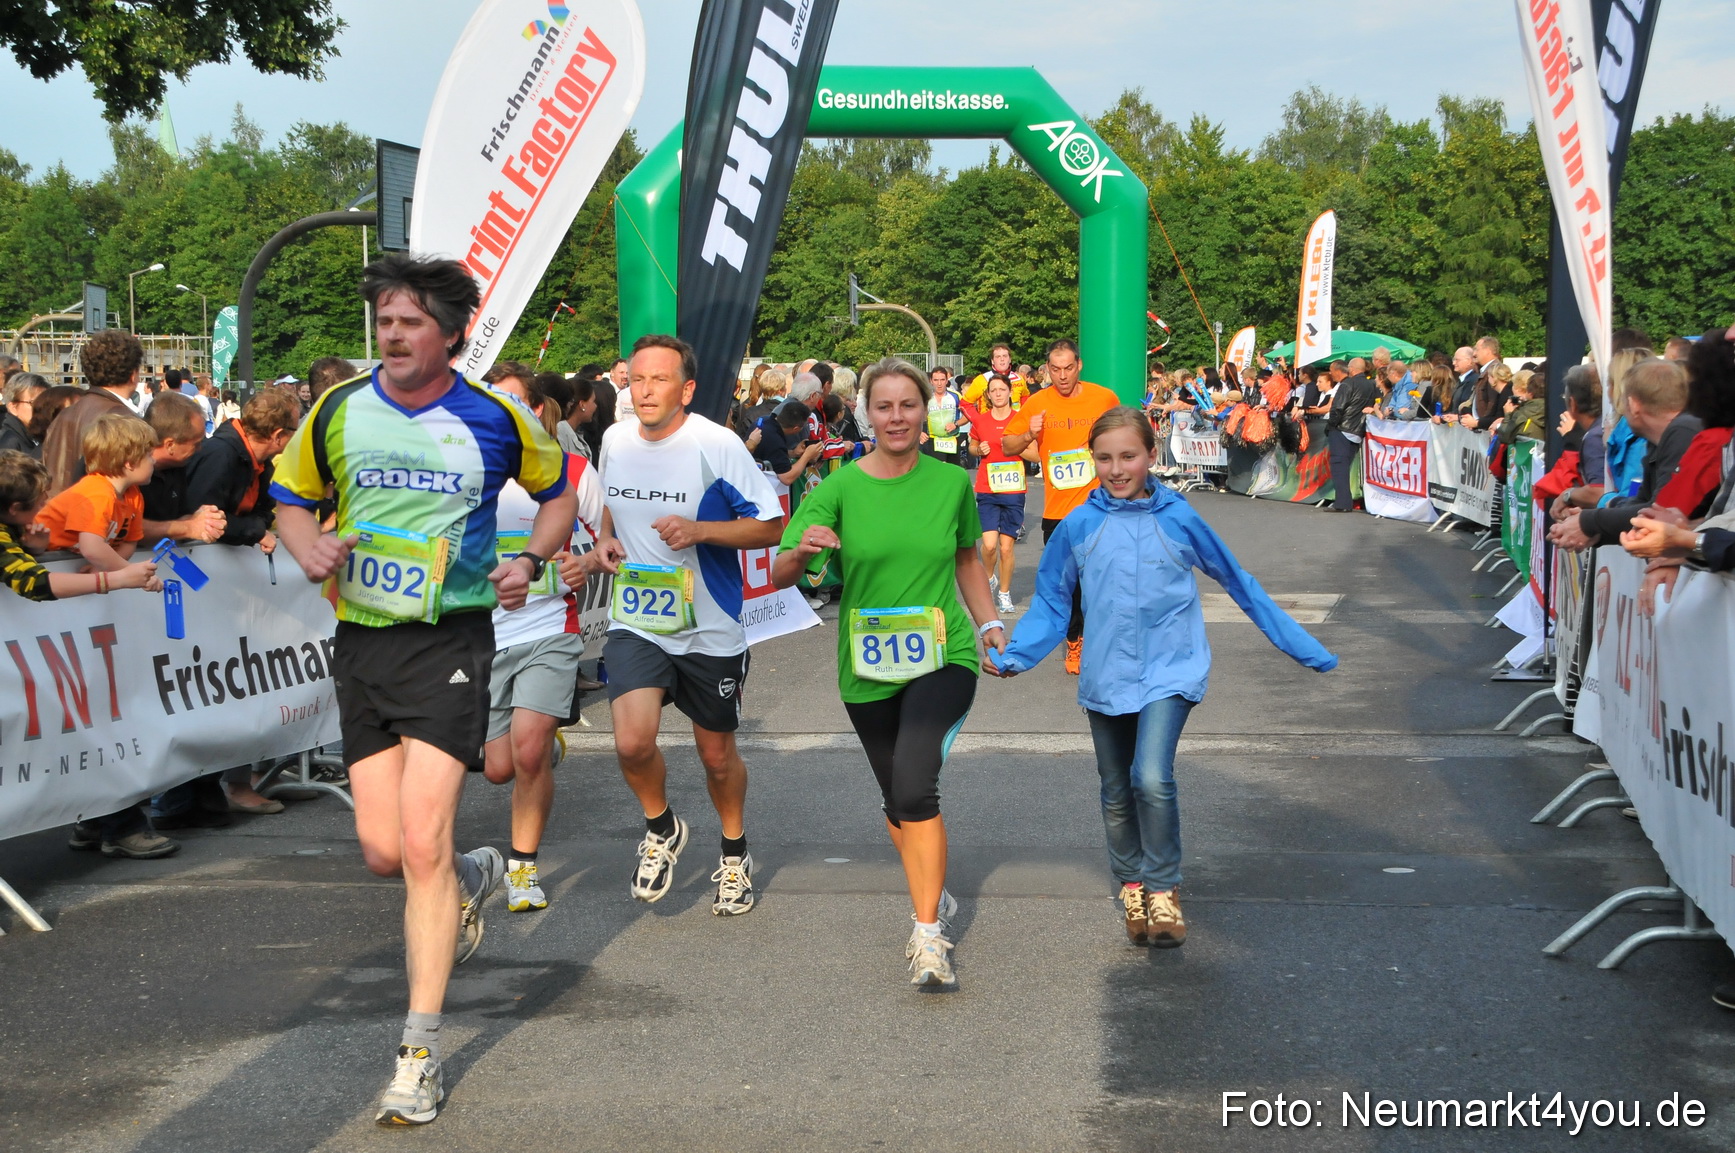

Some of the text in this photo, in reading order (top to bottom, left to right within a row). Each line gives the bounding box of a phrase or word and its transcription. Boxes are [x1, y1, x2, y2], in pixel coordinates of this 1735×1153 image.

[529, 70, 550, 102] Druck
[555, 14, 578, 53] Medien
[481, 26, 560, 163] Frischmann
[818, 88, 1010, 110] Gesundheitskasse.
[500, 26, 617, 199] Factory
[701, 0, 798, 273] THUL
[1027, 120, 1124, 204] AOK
[1308, 229, 1325, 316] KLEBL
[358, 450, 425, 466] TEAM
[936, 441, 954, 449] 1053
[990, 472, 1020, 485] 1148
[1053, 462, 1086, 481] 617
[1367, 439, 1422, 493] MEIER
[357, 468, 464, 495] BOCK
[608, 486, 687, 503] DELPHI
[346, 552, 426, 600] 1092
[357, 589, 385, 603] Jürgen
[622, 587, 677, 617] 922
[634, 615, 655, 624] Alfred
[862, 633, 926, 666] 819
[875, 665, 893, 673] Ruth
[280, 696, 320, 726] Druck
